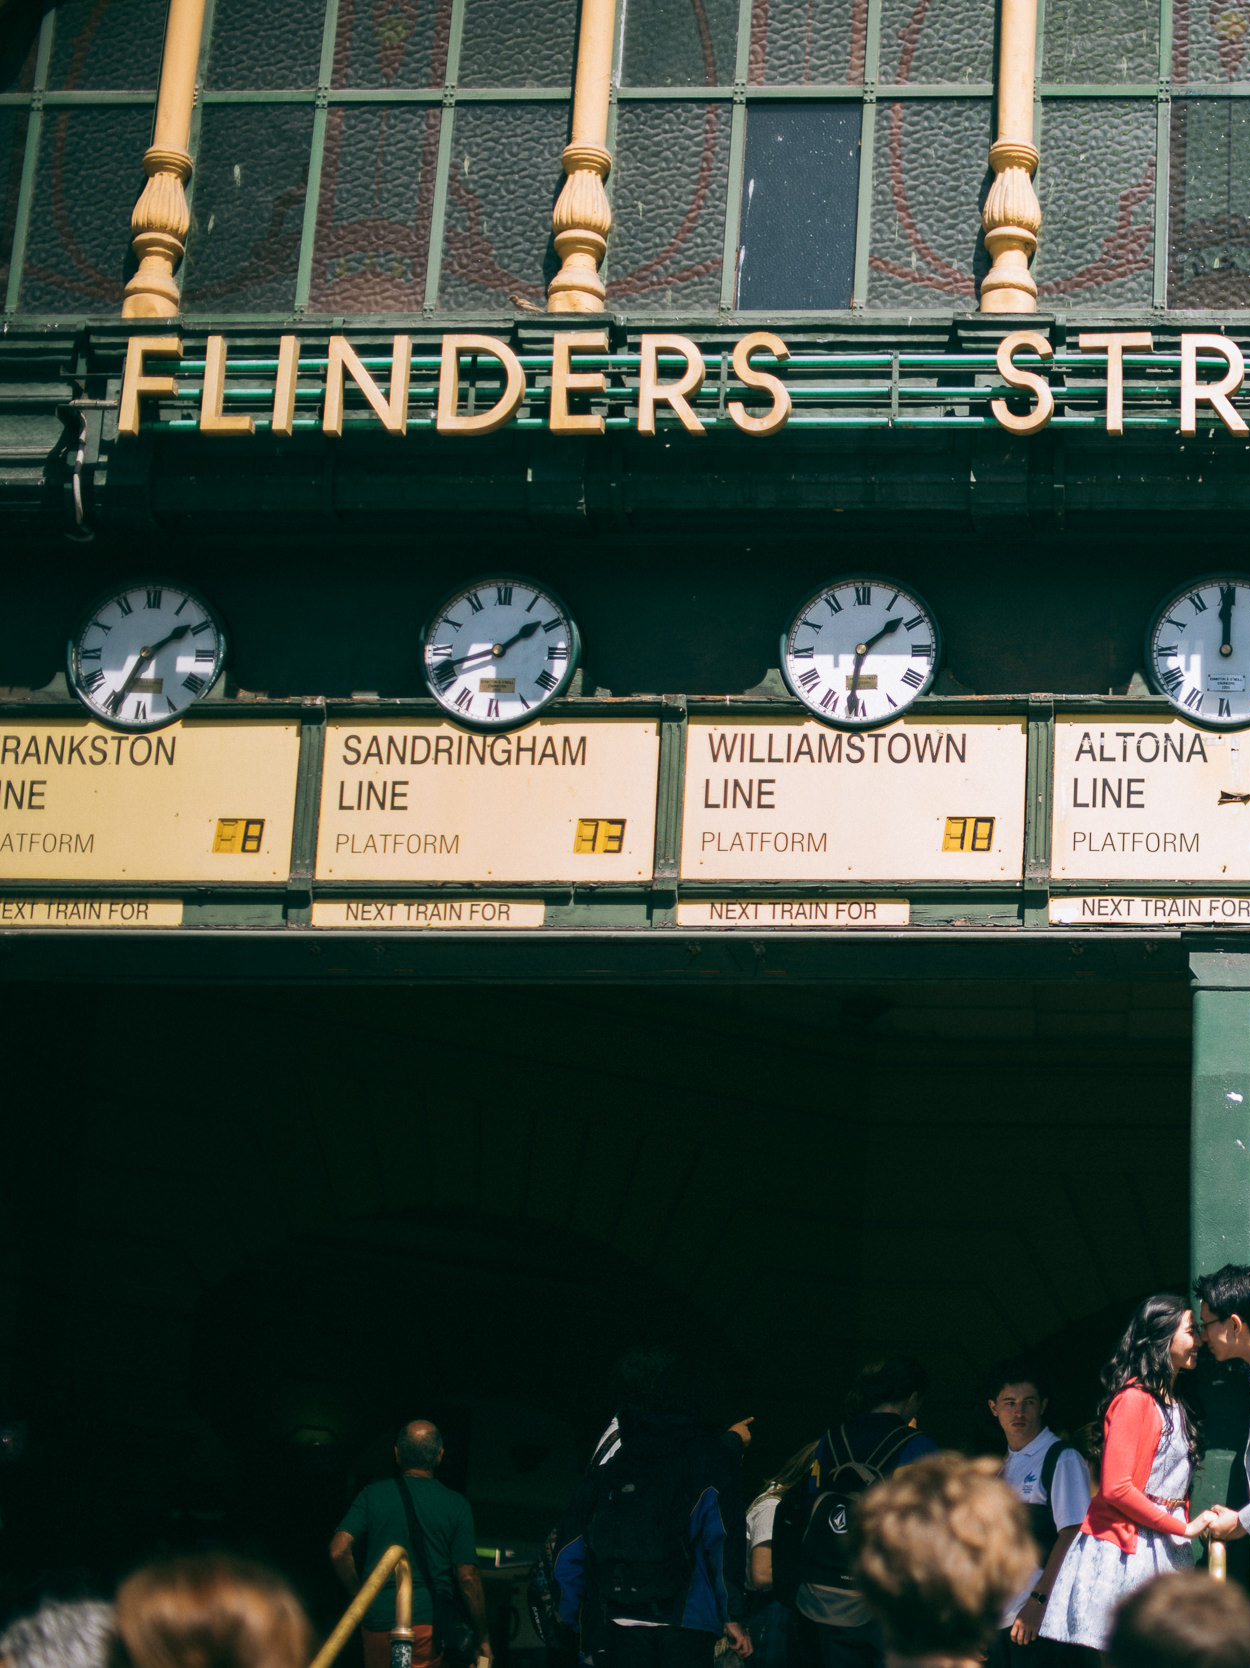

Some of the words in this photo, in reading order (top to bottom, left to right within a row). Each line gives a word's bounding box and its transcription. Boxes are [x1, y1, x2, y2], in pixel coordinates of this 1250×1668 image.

[118, 332, 792, 437] FLINDERS
[342, 735, 587, 766] SANDRINGHAM
[709, 733, 966, 763] WILLIAMSTOWN
[1075, 732, 1208, 763] ALTONA
[338, 781, 409, 810] LINE
[704, 779, 776, 808] LINE
[1073, 778, 1145, 808] LINE
[335, 834, 460, 854] PLATFORM
[702, 832, 827, 852] PLATFORM
[1073, 832, 1199, 852] PLATFORM
[47, 903, 102, 920] TRAIN
[108, 903, 149, 920] FOR
[346, 903, 396, 921] NEXT
[406, 903, 463, 921] TRAIN
[470, 904, 510, 921] FOR
[710, 902, 761, 920] NEXT
[768, 902, 828, 920] TRAIN
[836, 902, 877, 920] FOR
[1082, 898, 1134, 917] NEXT
[1141, 899, 1201, 917] TRAIN
[1209, 900, 1250, 917] FOR
